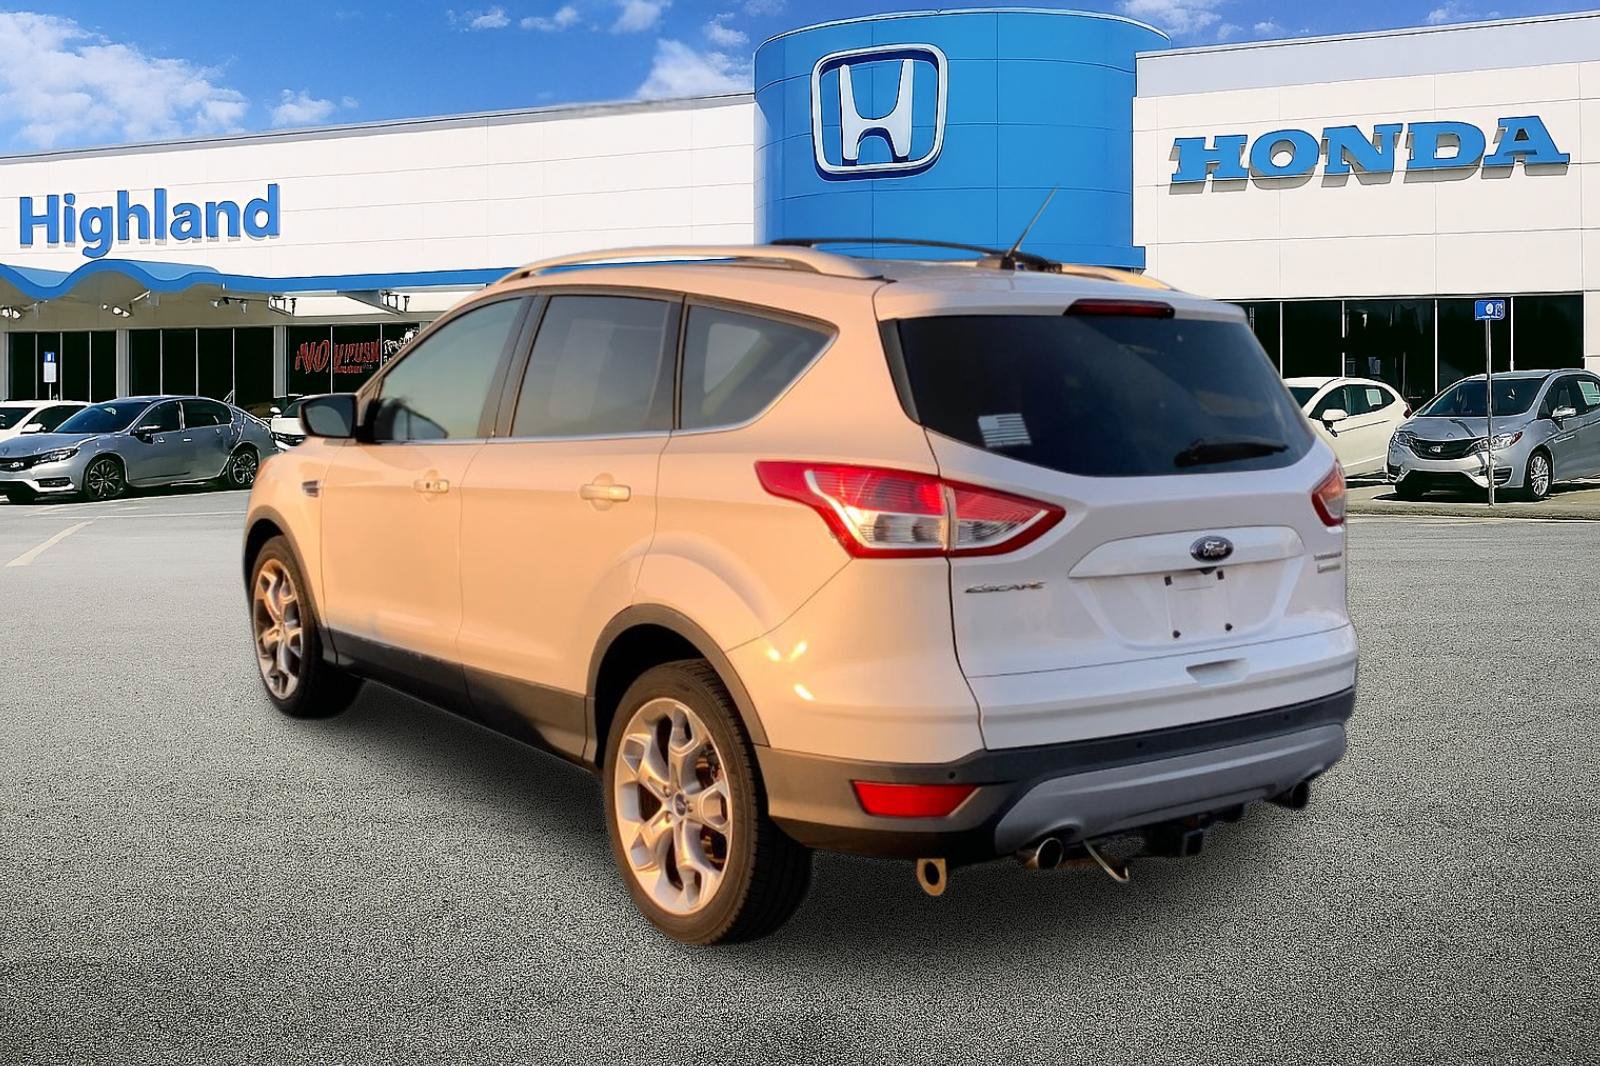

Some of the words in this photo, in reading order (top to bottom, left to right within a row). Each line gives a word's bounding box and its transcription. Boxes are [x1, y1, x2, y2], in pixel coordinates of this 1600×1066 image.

[1170, 115, 1571, 186] HONDA
[19, 183, 280, 259] Highland
[1203, 541, 1228, 557] Ford
